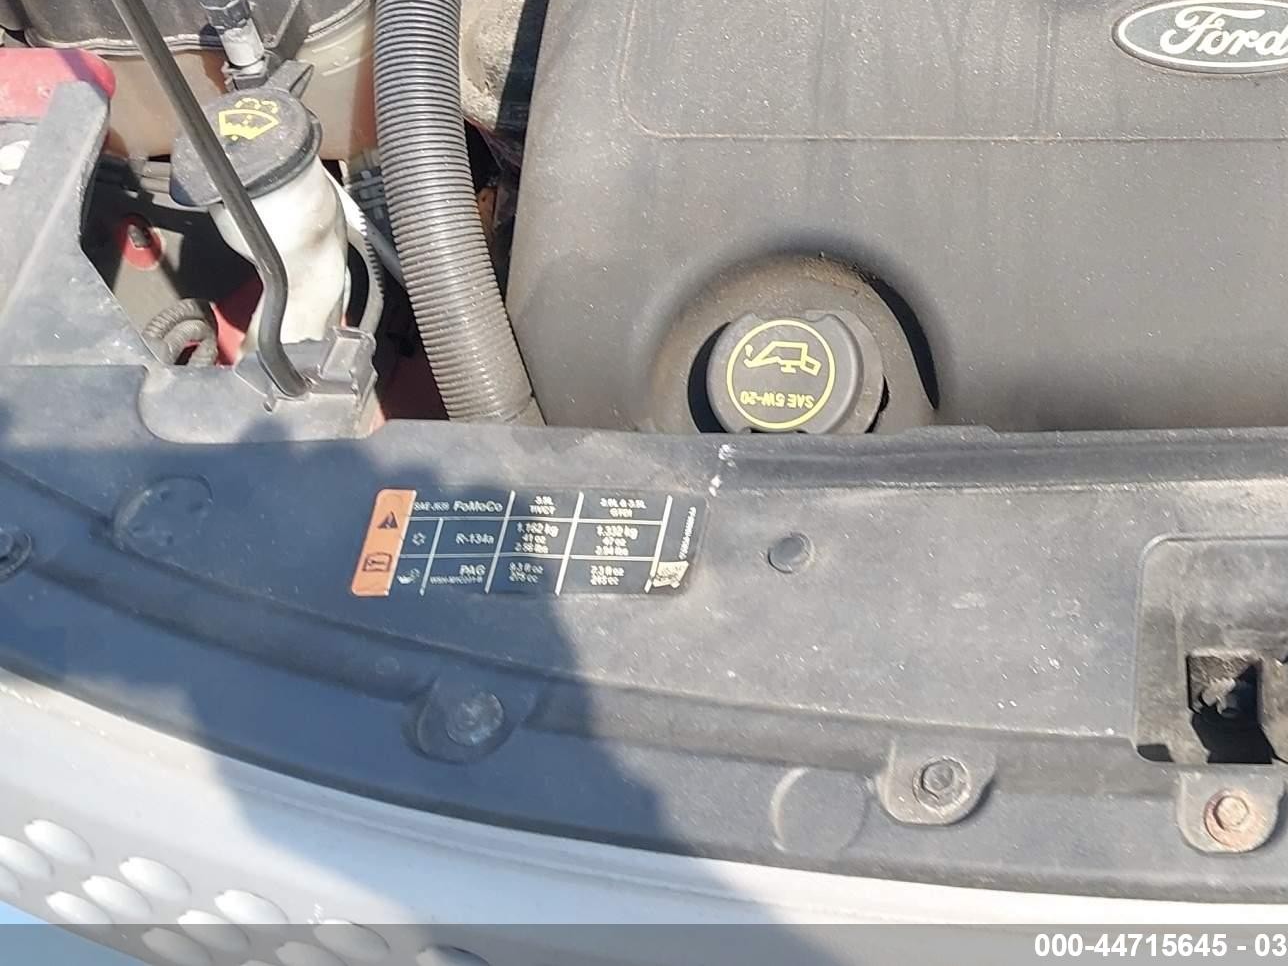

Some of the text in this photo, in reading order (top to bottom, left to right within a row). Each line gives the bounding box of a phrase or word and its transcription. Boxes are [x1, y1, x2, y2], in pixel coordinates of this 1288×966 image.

[741, 391, 815, 409] SAE 5W-20
[453, 500, 503, 513] FoMoCo
[455, 533, 495, 544] R-134a
[459, 564, 487, 576] PAG
